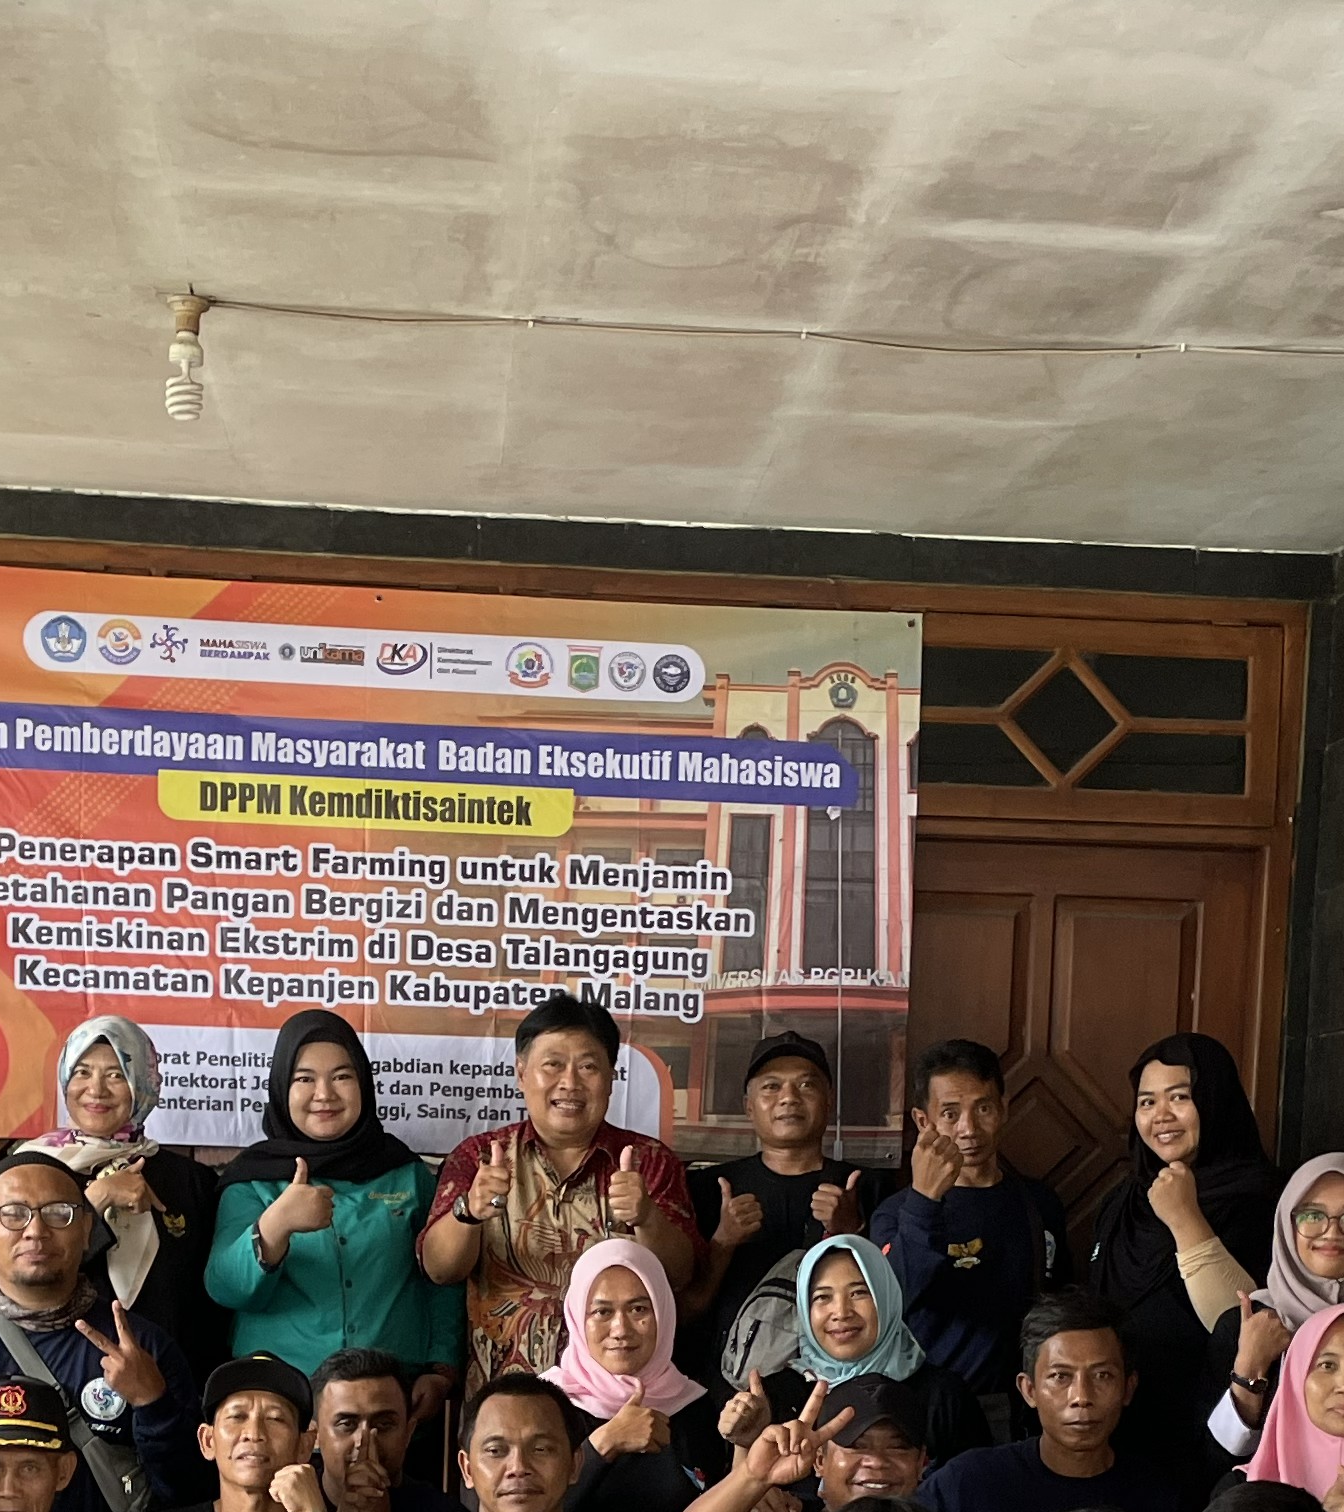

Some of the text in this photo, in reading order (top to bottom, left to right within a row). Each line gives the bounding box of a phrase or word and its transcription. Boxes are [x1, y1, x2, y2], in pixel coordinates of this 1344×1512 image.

[200, 637, 268, 651] MAHASISWA
[200, 649, 271, 661] BERDAMPAK
[15, 721, 244, 763] Pemberdayaan
[251, 731, 426, 770] Masyarakat
[438, 739, 532, 776] Badan
[538, 744, 673, 781] Eksekutif
[677, 750, 842, 789] Mahasiswa
[199, 780, 533, 827] DPPM Kemdiktisaintek
[190, 841, 298, 872] Smart
[312, 846, 446, 885] Farming
[460, 857, 556, 884] untuk
[569, 858, 729, 893] Menjamin
[166, 882, 291, 918] Pangan
[305, 888, 423, 925] Bergizi
[436, 894, 494, 924] dan
[508, 896, 752, 933] Mengentaskan
[11, 916, 709, 978] Kemiskinan Ekstrim di Desa Talangagung
[18, 958, 210, 994] Kecamatan
[223, 968, 375, 1004] Kepanjen
[581, 982, 701, 1018] Malang
[161, 1071, 247, 1091] irektorat
[389, 1081, 424, 1097] dan
[429, 1082, 524, 1103] Pengemba
[195, 1050, 274, 1069] Penelitia
[371, 1058, 444, 1076] gabdian
[449, 1060, 516, 1079] kepada
[416, 1104, 472, 1124] Sains,
[477, 1104, 511, 1122] dan
